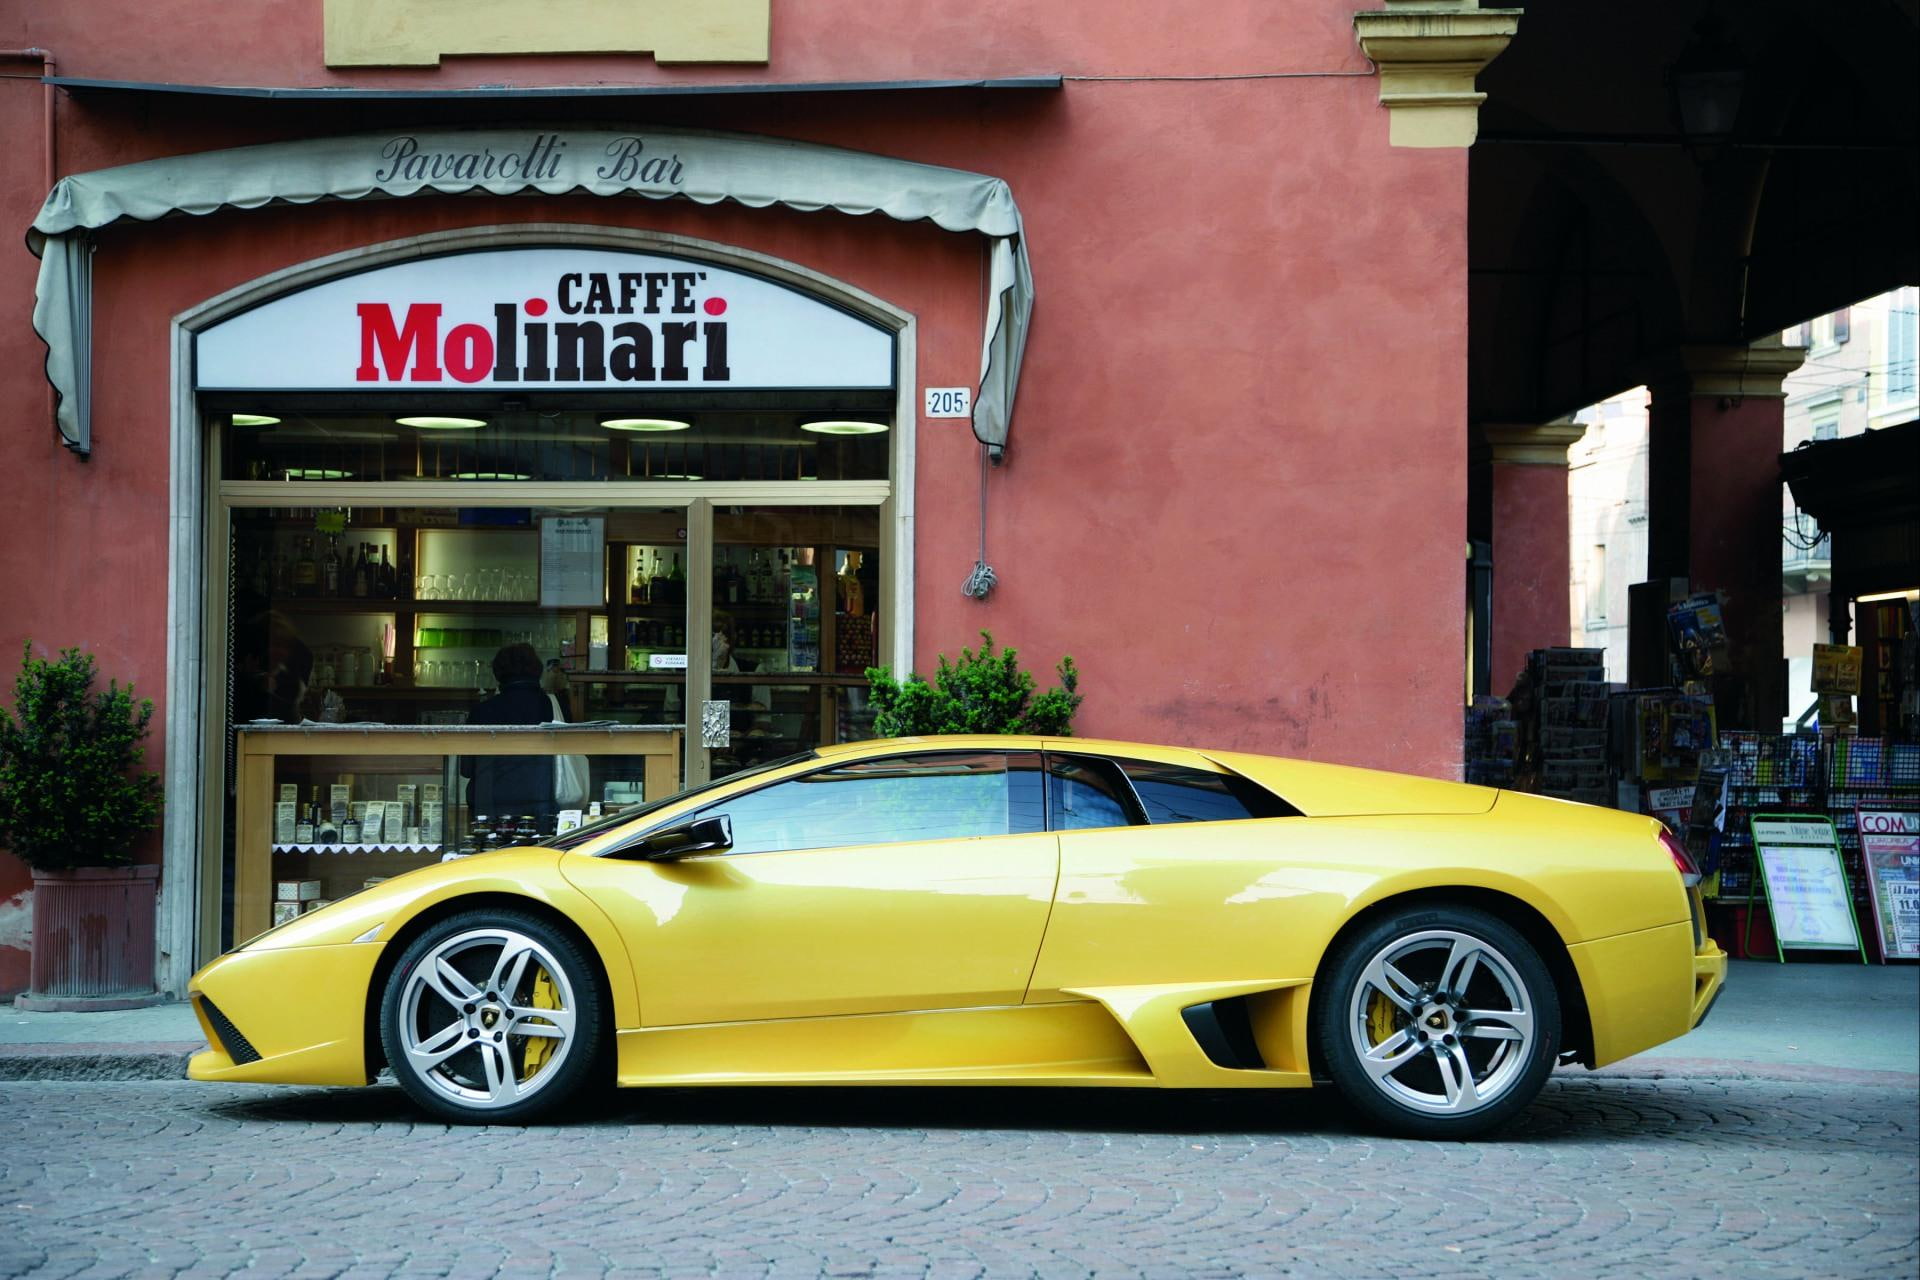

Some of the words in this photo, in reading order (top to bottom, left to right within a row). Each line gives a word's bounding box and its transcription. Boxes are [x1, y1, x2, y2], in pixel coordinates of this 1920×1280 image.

[375, 134, 567, 181] Pavarotti
[597, 137, 685, 186] Bar
[356, 297, 731, 384] Molinari
[931, 392, 964, 413] 205
